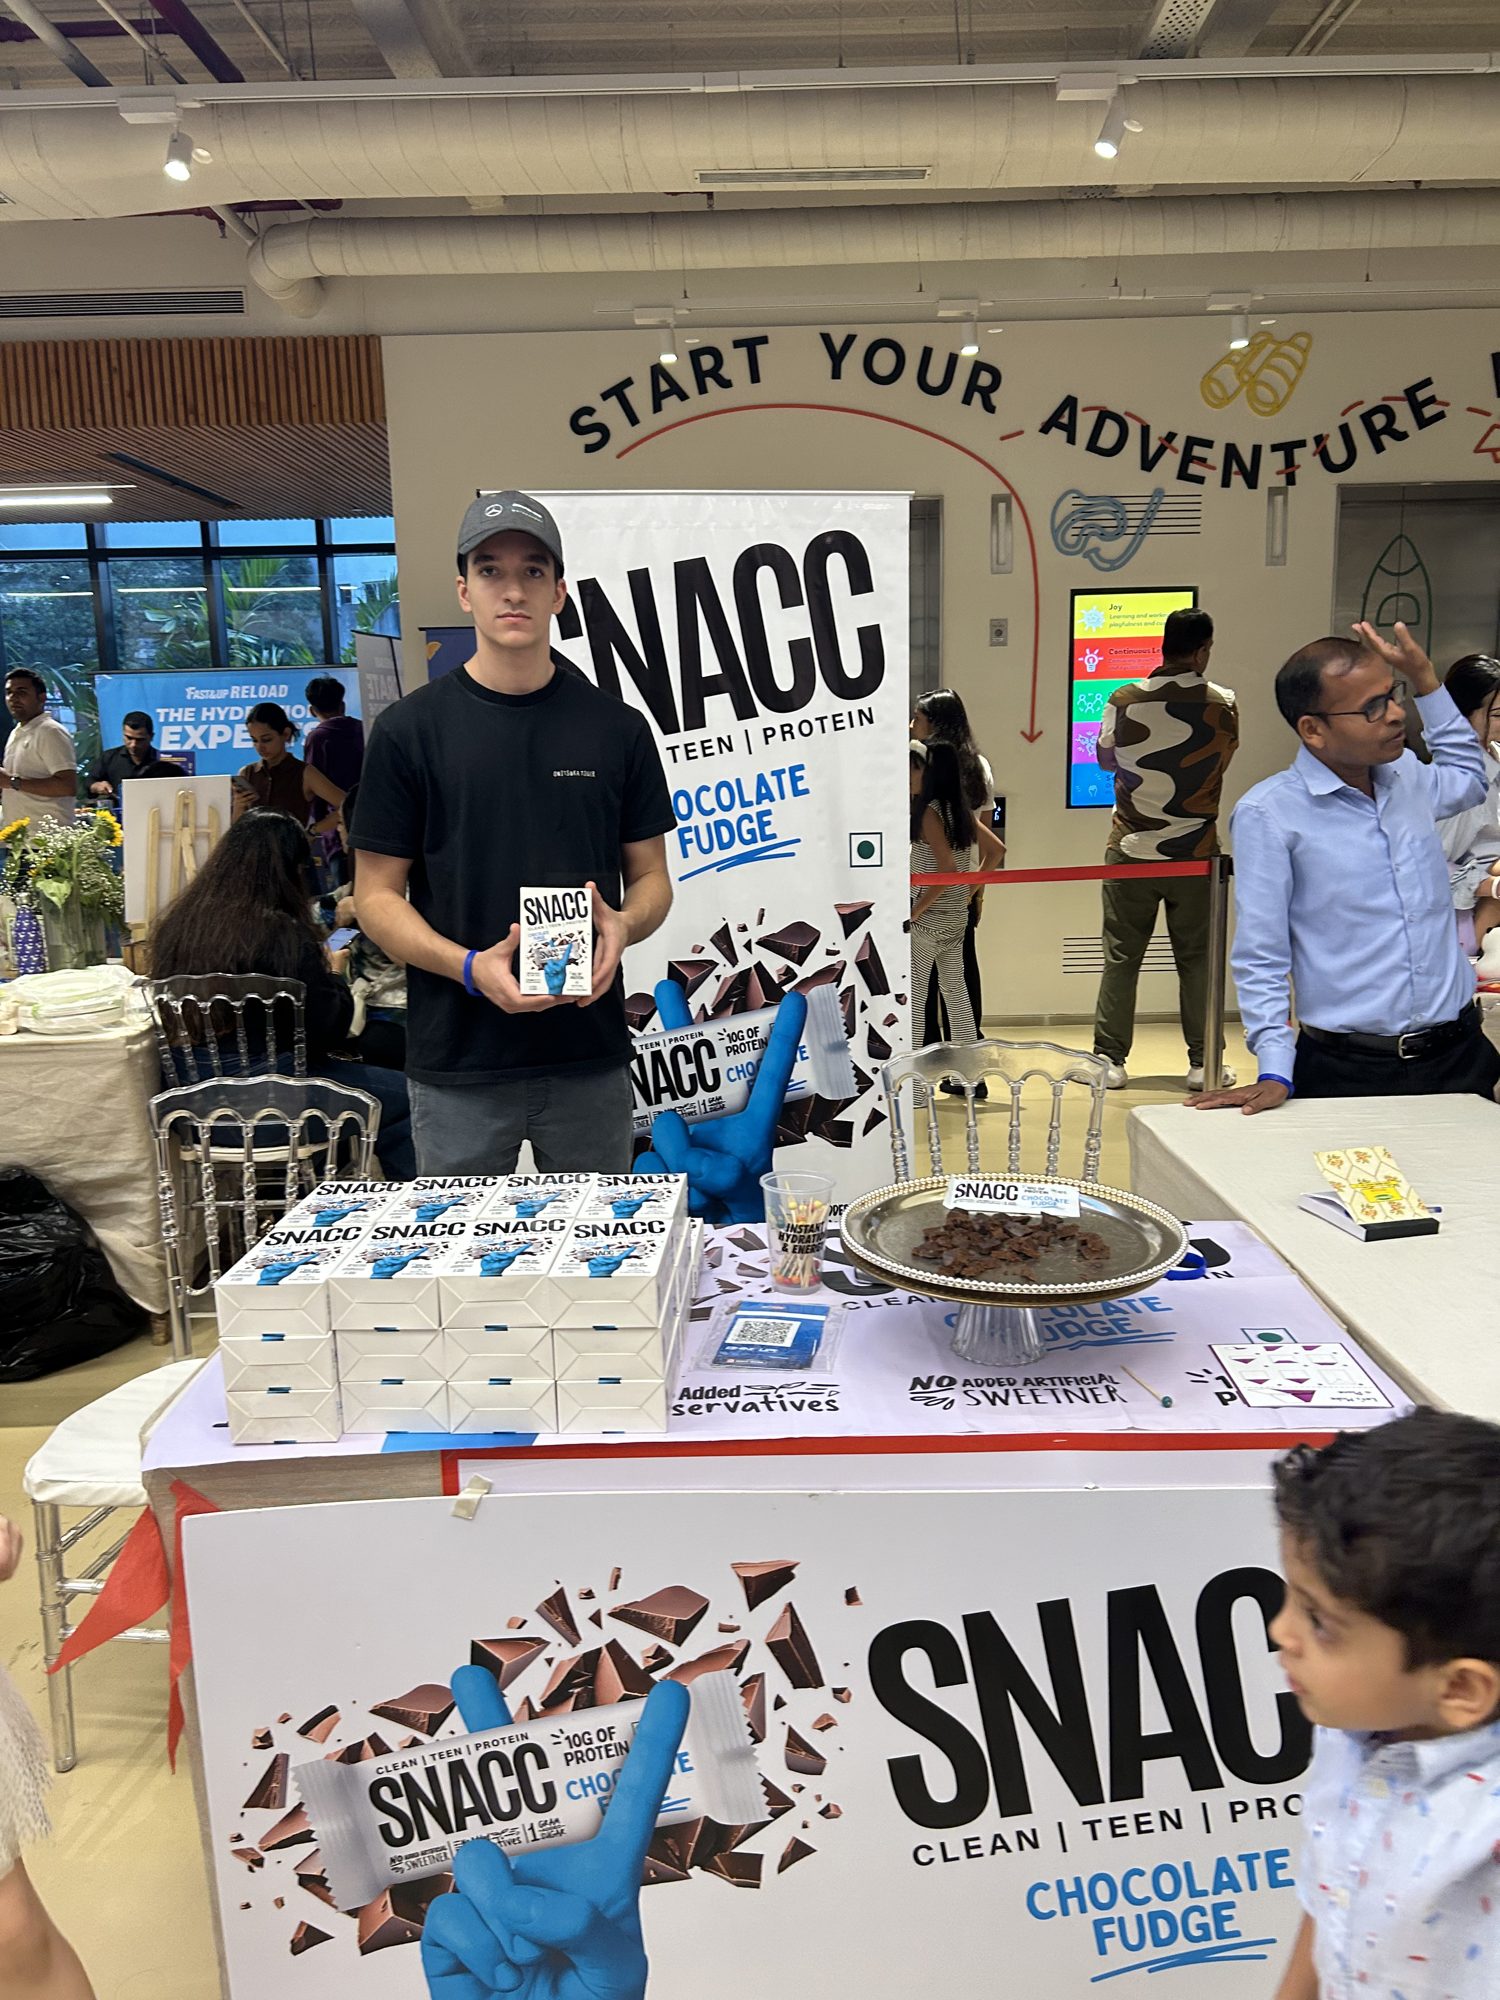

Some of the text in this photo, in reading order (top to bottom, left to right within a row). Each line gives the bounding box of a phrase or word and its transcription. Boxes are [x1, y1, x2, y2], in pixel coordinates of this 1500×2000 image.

[569, 332, 1447, 491] START YOUR ADVENTURE
[231, 685, 289, 699] RELOAD
[156, 707, 196, 722] THE
[666, 706, 875, 763] TEEN PROTEIN
[678, 809, 778, 858] FUDGE
[524, 891, 588, 925] SNACC
[639, 1030, 704, 1050] TEEN PROTEIN
[726, 1026, 760, 1043] 10G OF
[726, 1037, 768, 1057] PROTEIN
[317, 1182, 403, 1196] SNACC
[413, 1177, 498, 1191] SNACC
[507, 1173, 591, 1188] SNACC
[597, 1174, 681, 1188] SNACC
[955, 1183, 1018, 1200] SNACC
[1021, 1195, 1070, 1204] CHOCOLATE
[265, 1227, 362, 1246] SNACC
[371, 1221, 466, 1240] SNACC
[473, 1219, 566, 1237] SNACC
[574, 1220, 665, 1239] SNACC
[782, 1243, 788, 1252] &
[909, 1373, 1120, 1391] NO ADDED ARTIFICIAL
[679, 1385, 741, 1400] Added
[963, 1385, 1127, 1407] SWEETNER
[672, 1395, 840, 1416] servatives
[565, 1726, 616, 1749] 10G OF
[376, 1732, 529, 1774] CLEAN TEEN PROTEIN
[564, 1740, 630, 1766] PROTEIN
[368, 1742, 557, 1848] SNACC
[528, 1823, 540, 1842] 1
[913, 1828, 1041, 1866] CLEAN
[1083, 1808, 1184, 1842] TEEN
[1027, 1848, 1296, 1920] CHOCOLATE
[1093, 1901, 1242, 1955] FUDGE
